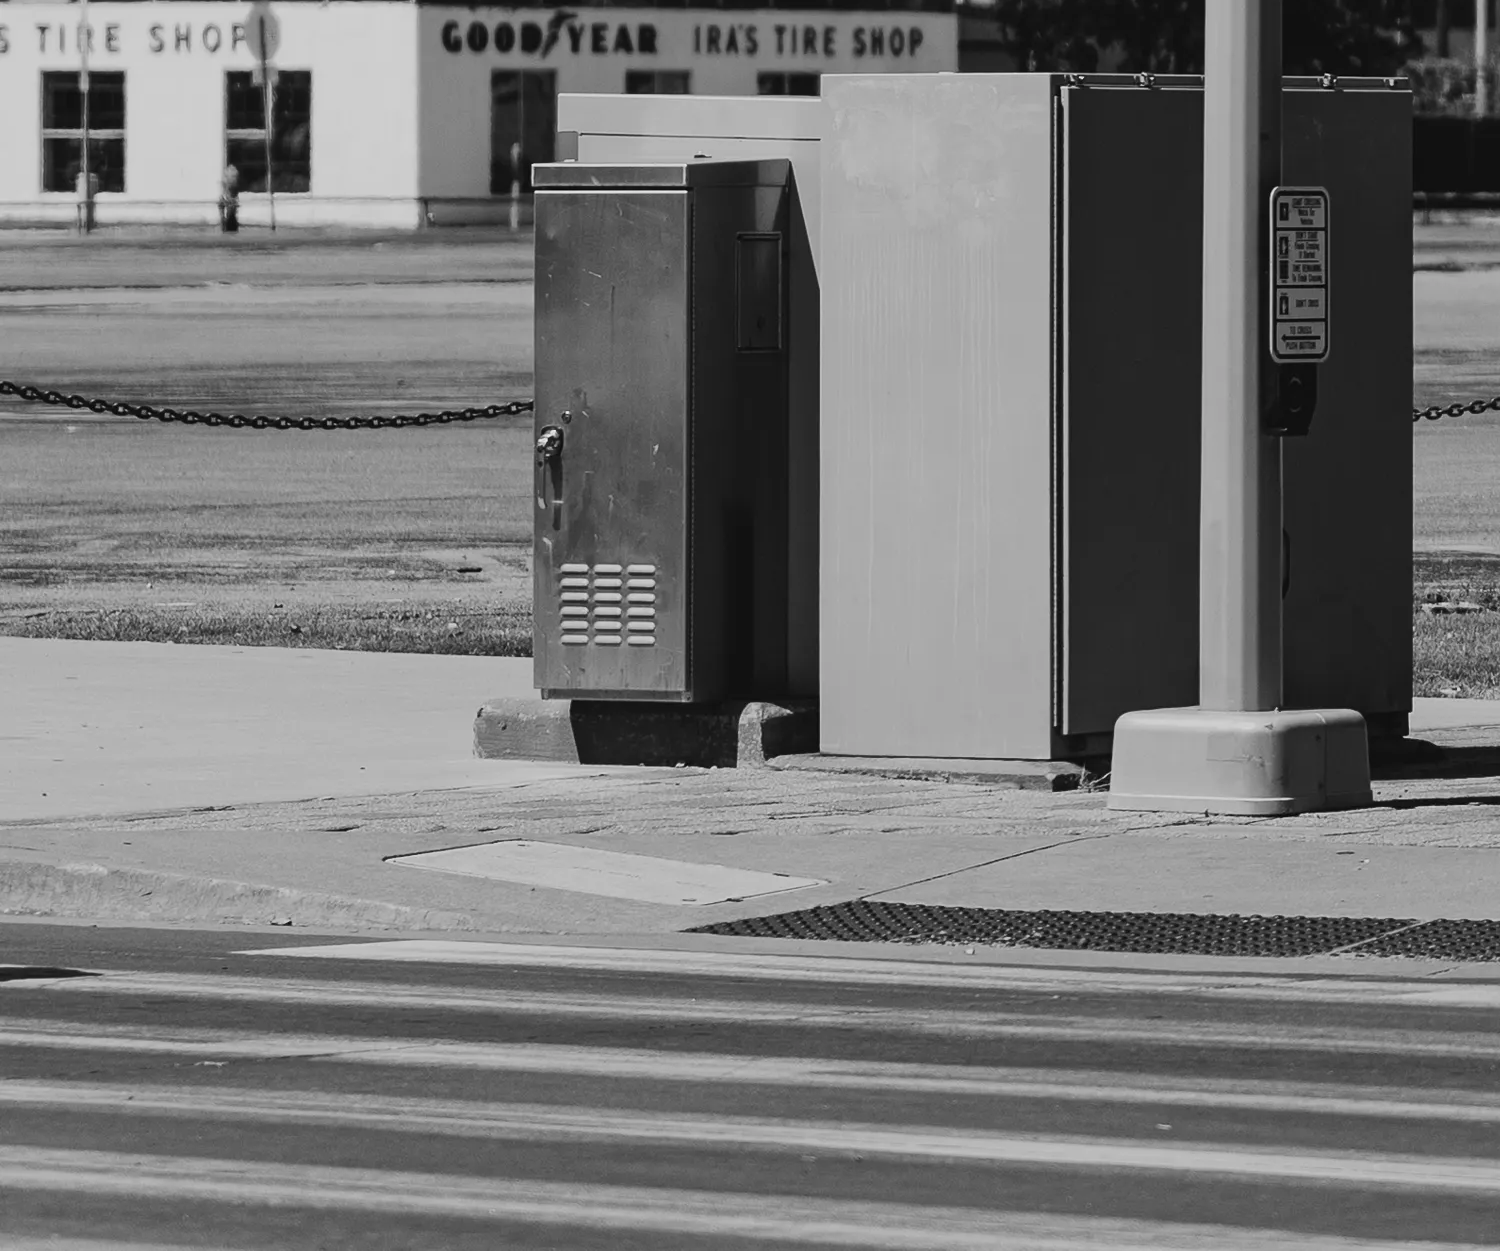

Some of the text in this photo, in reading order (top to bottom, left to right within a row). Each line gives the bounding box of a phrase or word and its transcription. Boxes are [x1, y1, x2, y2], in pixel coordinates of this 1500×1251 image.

[35, 22, 121, 54] TIRE
[149, 22, 246, 54] SHOP
[693, 24, 925, 59] IRA'S TIRE SHOP
